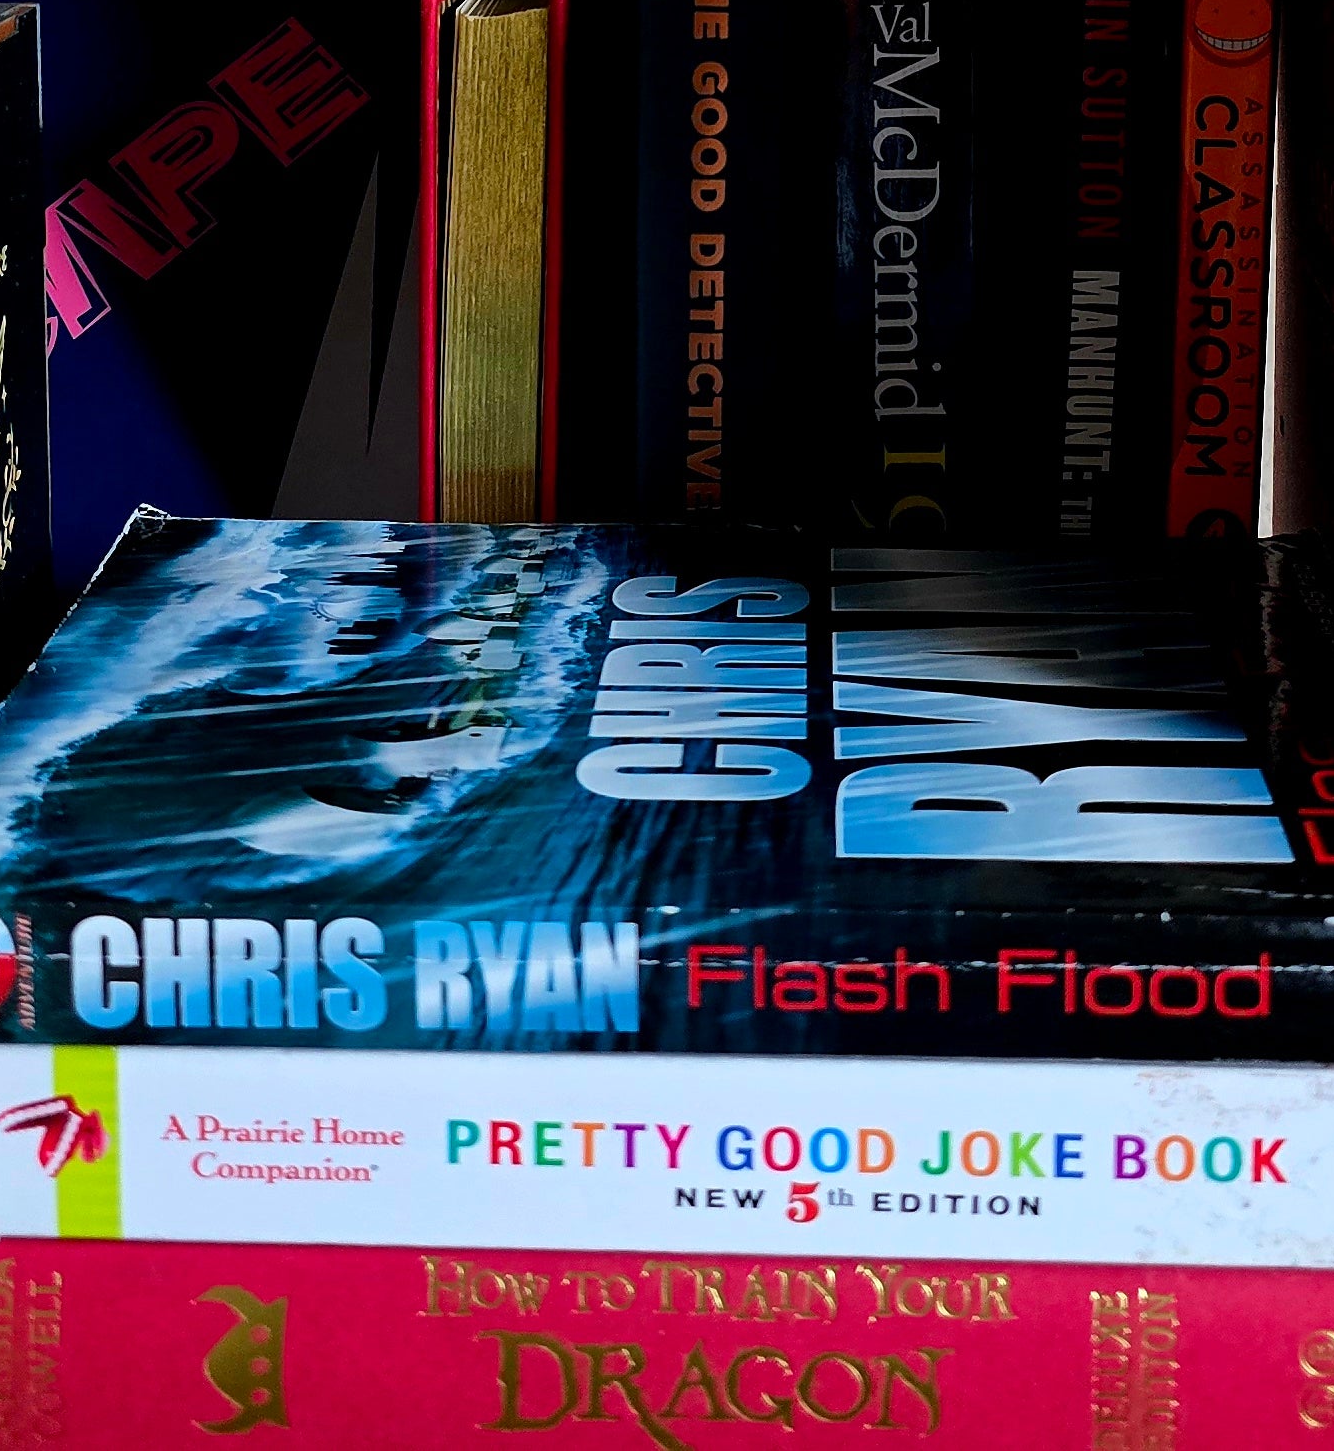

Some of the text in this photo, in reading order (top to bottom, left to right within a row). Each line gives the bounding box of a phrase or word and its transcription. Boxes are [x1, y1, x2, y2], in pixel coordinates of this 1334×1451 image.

[870, 3, 932, 43] Val
[690, 61, 729, 212] GOOD
[1077, 67, 1128, 240] SUTTON
[872, 46, 947, 422] McDermid
[1183, 94, 1240, 476] CLASSROOM
[1233, 96, 1266, 480] ASSASSINATION
[685, 234, 726, 512] DETECTIVE
[1064, 269, 1121, 482] MANHUNT:
[576, 575, 811, 801] CHRIS
[72, 915, 640, 1032] CHRIS RYAN
[686, 944, 1271, 1018] Flash Flood
[160, 1114, 405, 1146] A Prairie Home
[447, 1118, 1288, 1185] PRETTY GOOD JOKE BOOK
[675, 1181, 1041, 1224] NEW 5th EDITION
[420, 1255, 1019, 1325] HOW TO TRAIN YOUR
[470, 1329, 956, 1451] DRAGON
[1089, 1290, 1131, 1451] DELUXE
